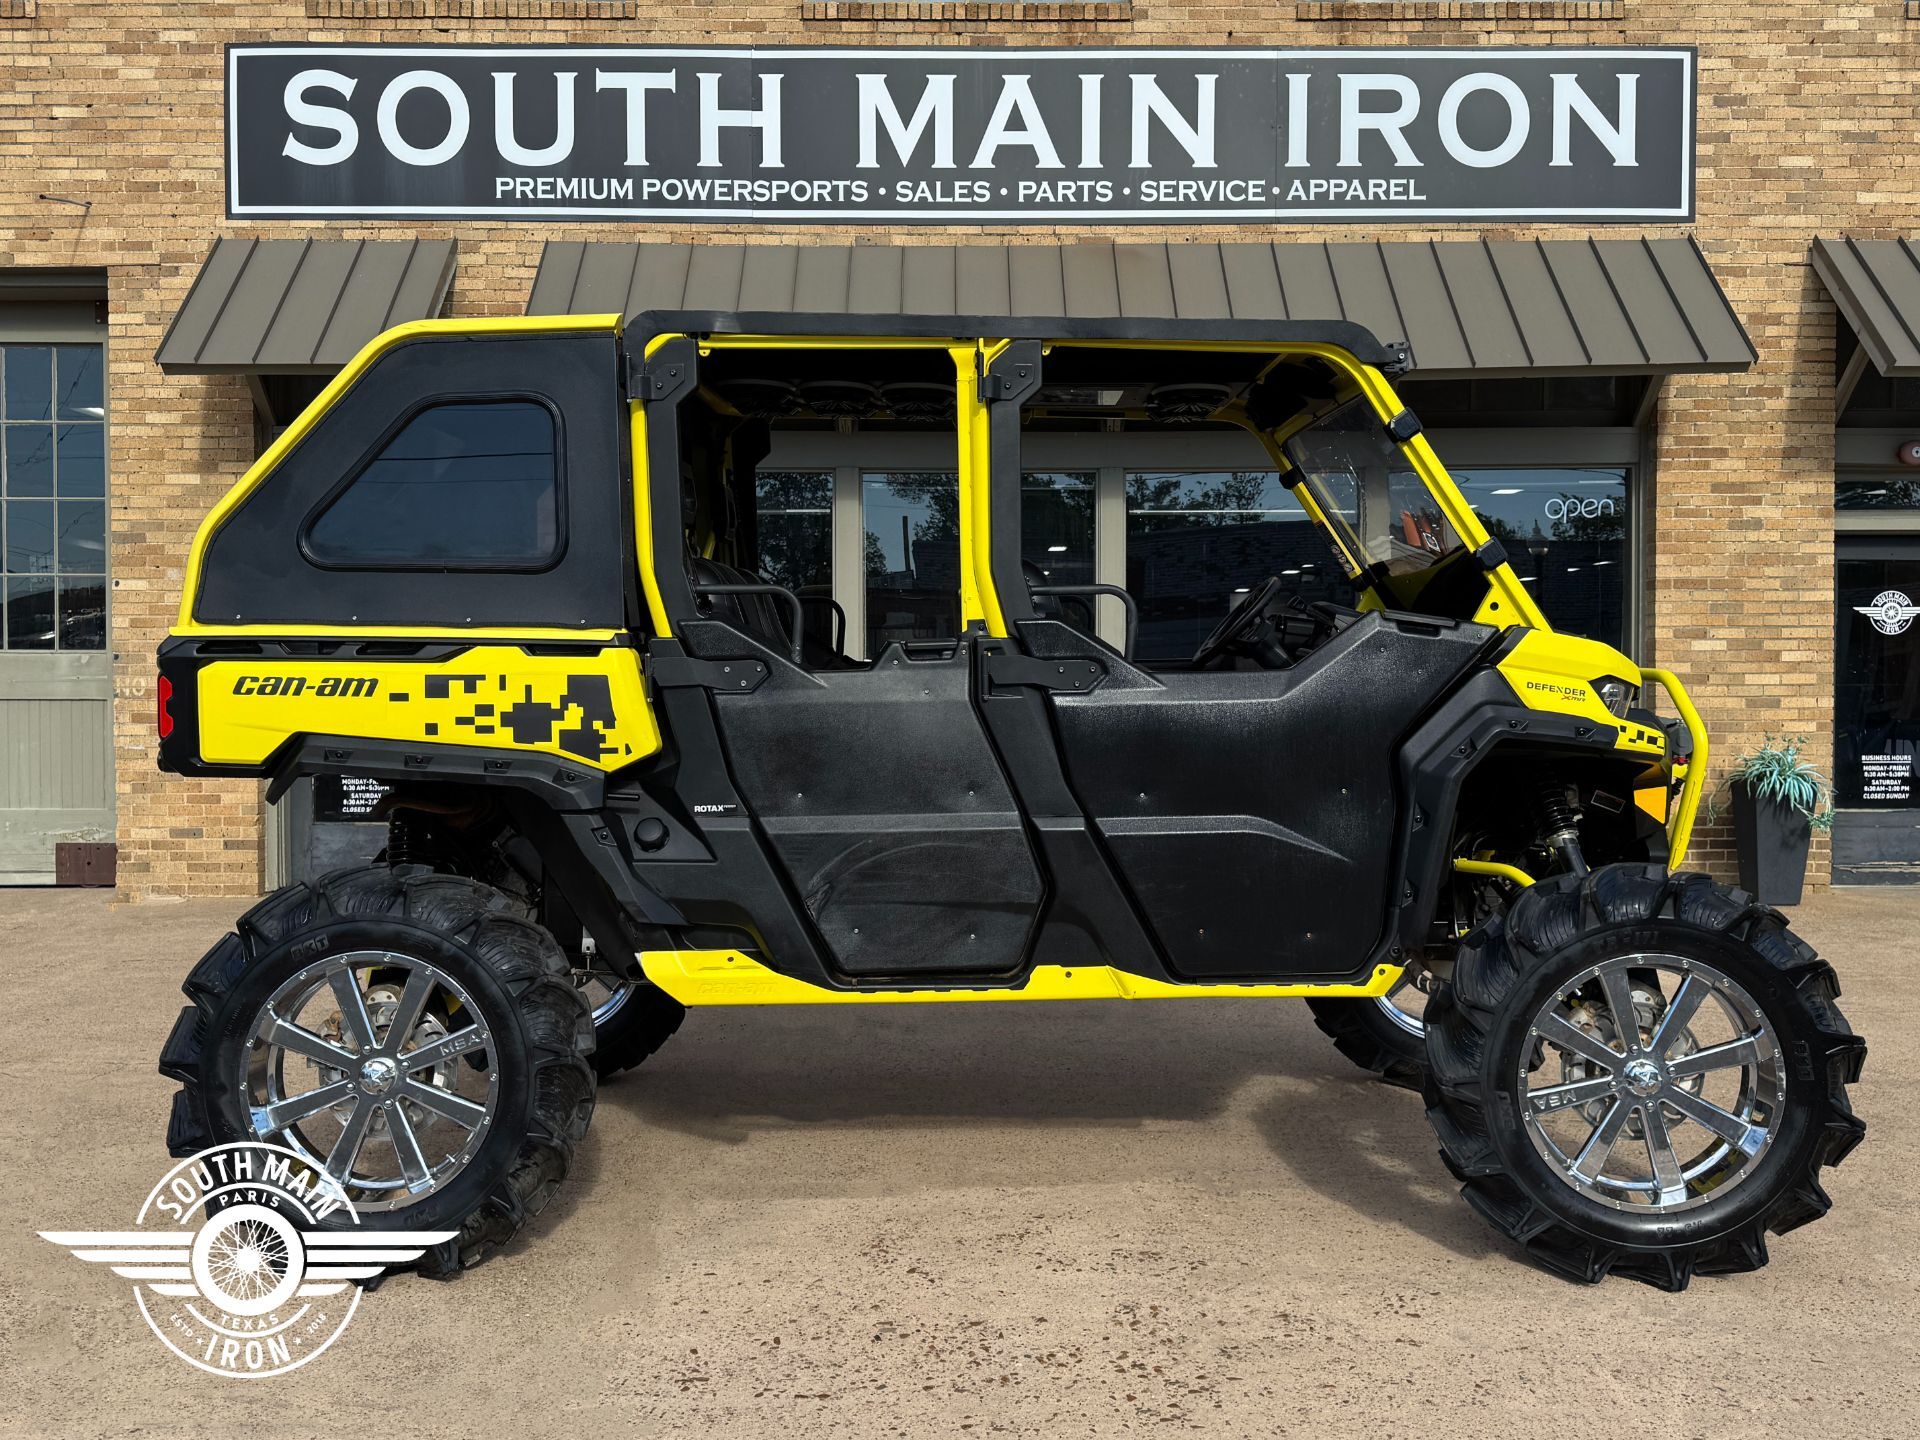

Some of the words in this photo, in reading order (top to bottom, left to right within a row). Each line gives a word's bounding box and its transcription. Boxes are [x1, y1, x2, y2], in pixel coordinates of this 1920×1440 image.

[283, 68, 784, 168] SOUTH
[856, 73, 1218, 169] MAIN
[1285, 72, 1640, 168] IRON
[495, 177, 634, 200] PREMIUM
[642, 178, 869, 203] POWERSPORTS
[895, 180, 991, 203] SALES
[1018, 180, 1113, 203] PARTS
[1140, 179, 1266, 203] SERVICE
[1285, 178, 1427, 201] APPAREL
[1544, 498, 1614, 524] open
[232, 676, 379, 697] can-am
[1527, 681, 1586, 697] DEFENDER
[694, 804, 724, 813] ROTAX
[440, 1033, 480, 1056] MSA
[1534, 1090, 1577, 1109] MSA
